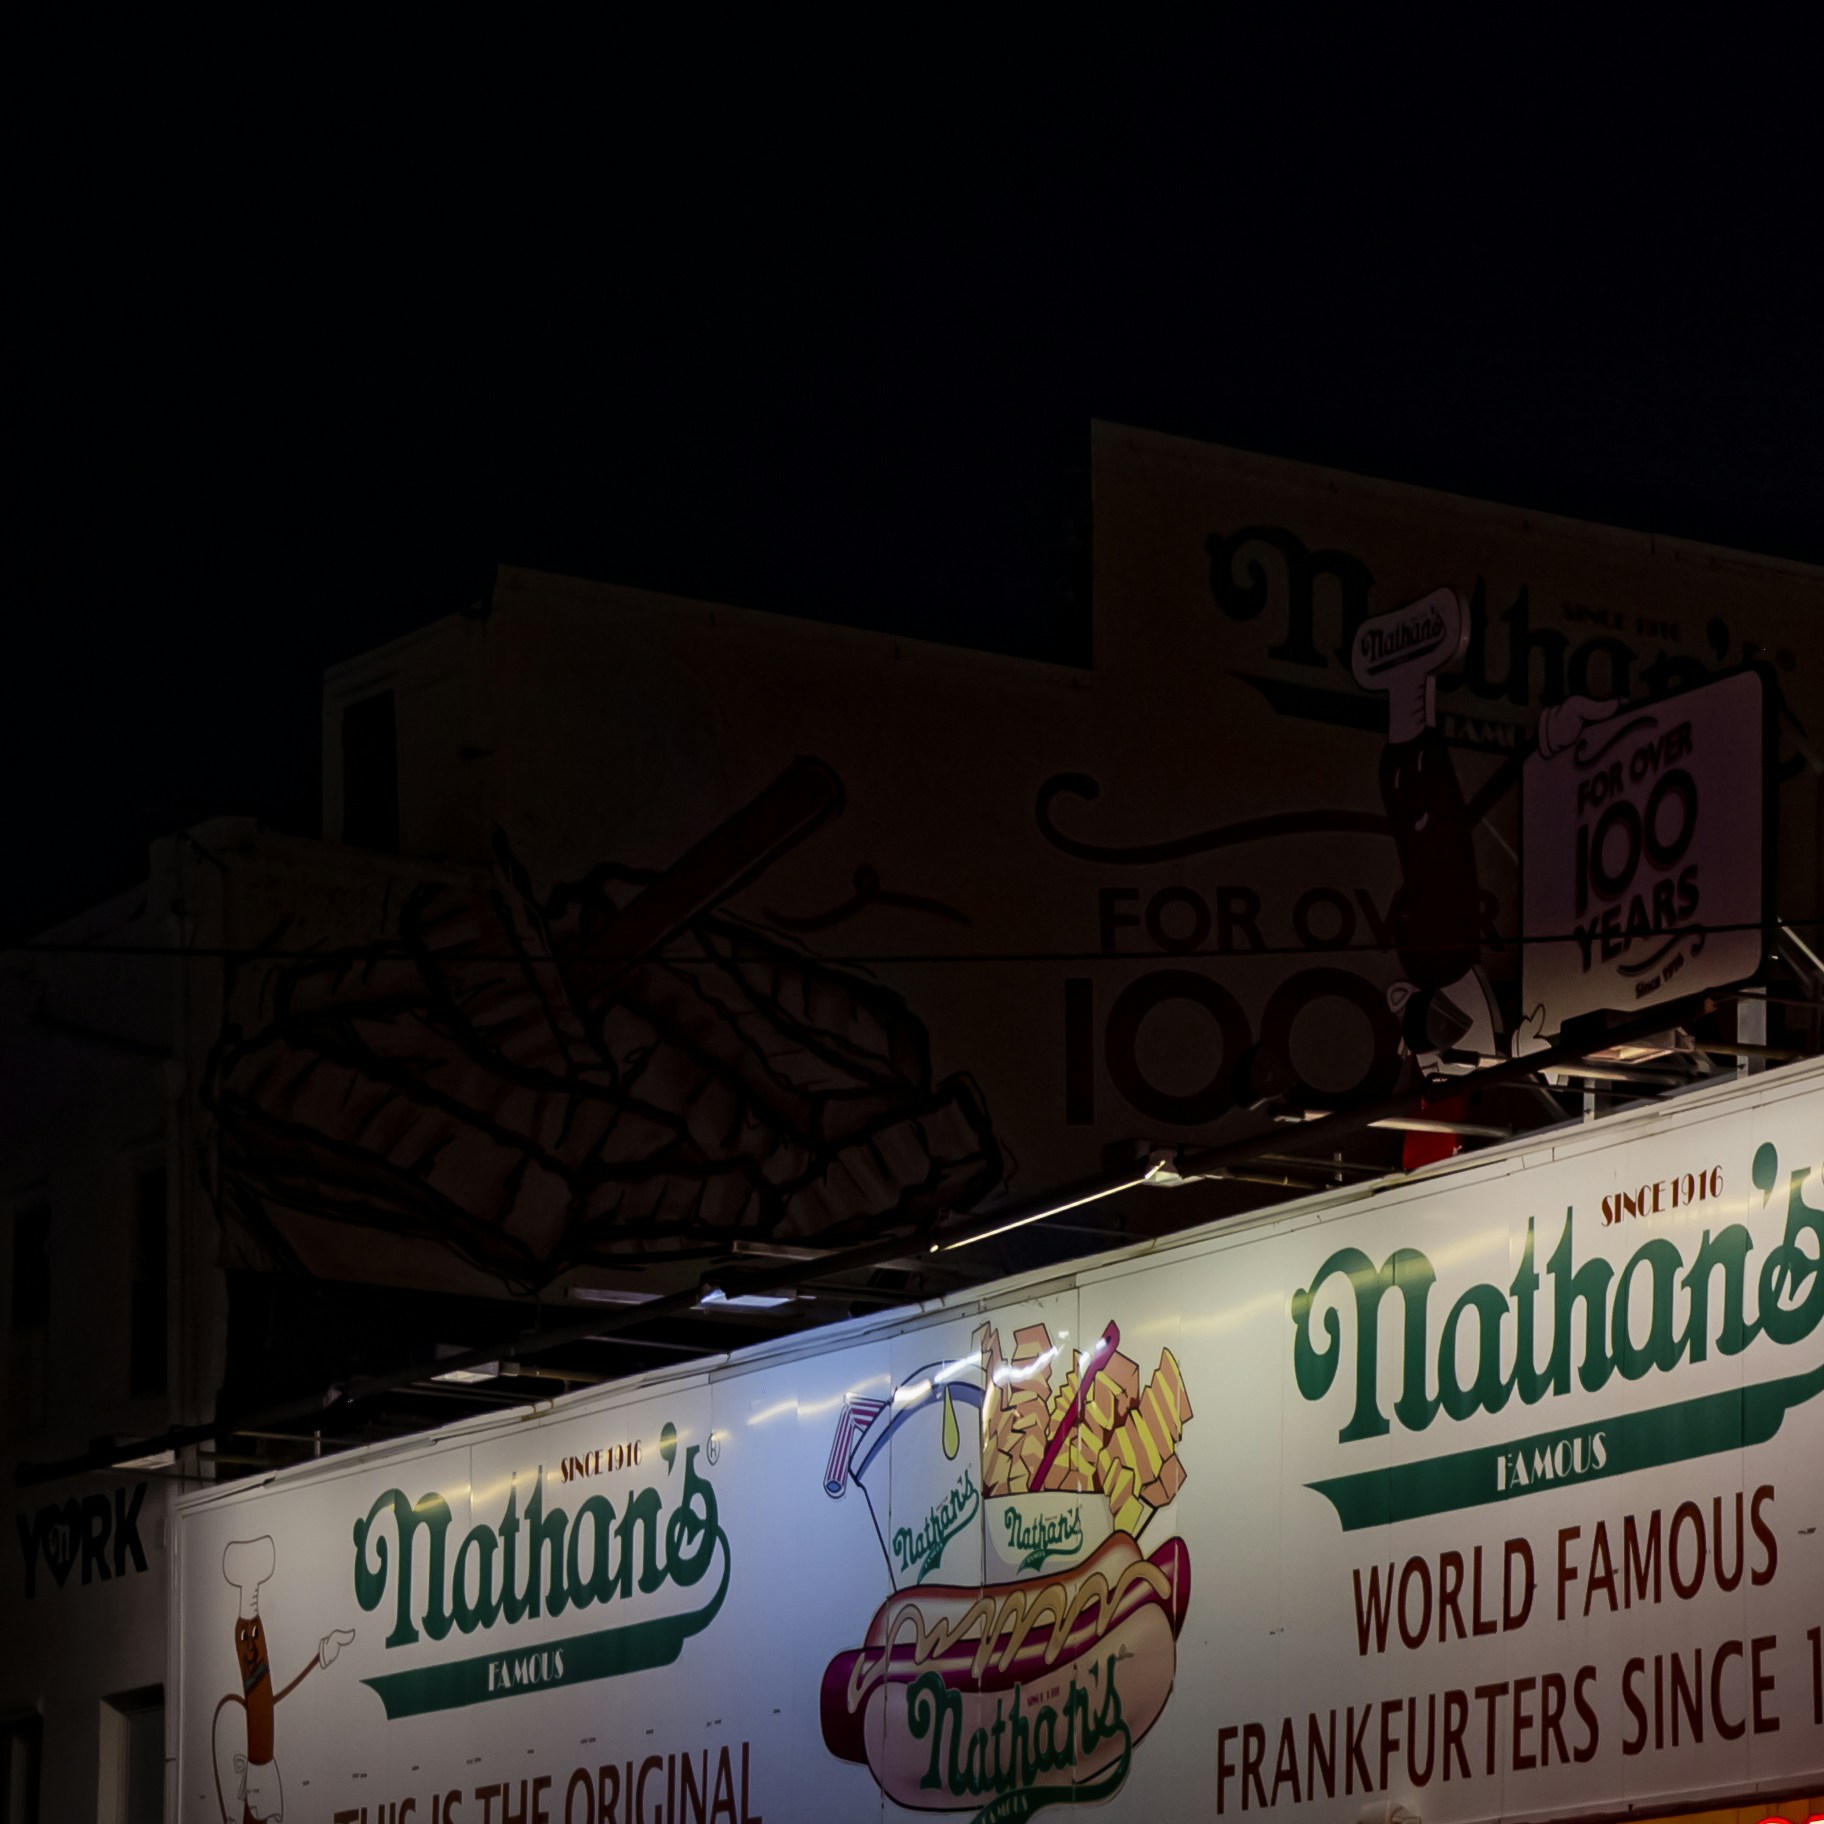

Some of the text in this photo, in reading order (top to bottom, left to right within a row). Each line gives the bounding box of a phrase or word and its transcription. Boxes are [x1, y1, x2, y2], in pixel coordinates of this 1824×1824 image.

[1577, 721, 1693, 817] FOR OVER
[1575, 768, 1698, 919] 100
[1097, 887, 1265, 957] FOR
[1574, 864, 1699, 973] YEARS
[1066, 968, 1404, 1127] 100
[1601, 1164, 1726, 1228] SINCE 1916
[560, 1453, 600, 1486] SINCE
[1496, 1432, 1607, 1493] FAMOUS
[355, 1420, 731, 1649] Nathan's
[893, 1468, 980, 1573] Nathan's
[1004, 1505, 1084, 1550] Nathan's
[1353, 1483, 1780, 1657] WORLD FAMOUS
[487, 1647, 565, 1693] FAMOUS
[906, 1650, 1133, 1797] Nathan's
[1216, 1664, 1600, 1816] FRANKFURTERS
[1621, 1635, 1781, 1757] SINCE
